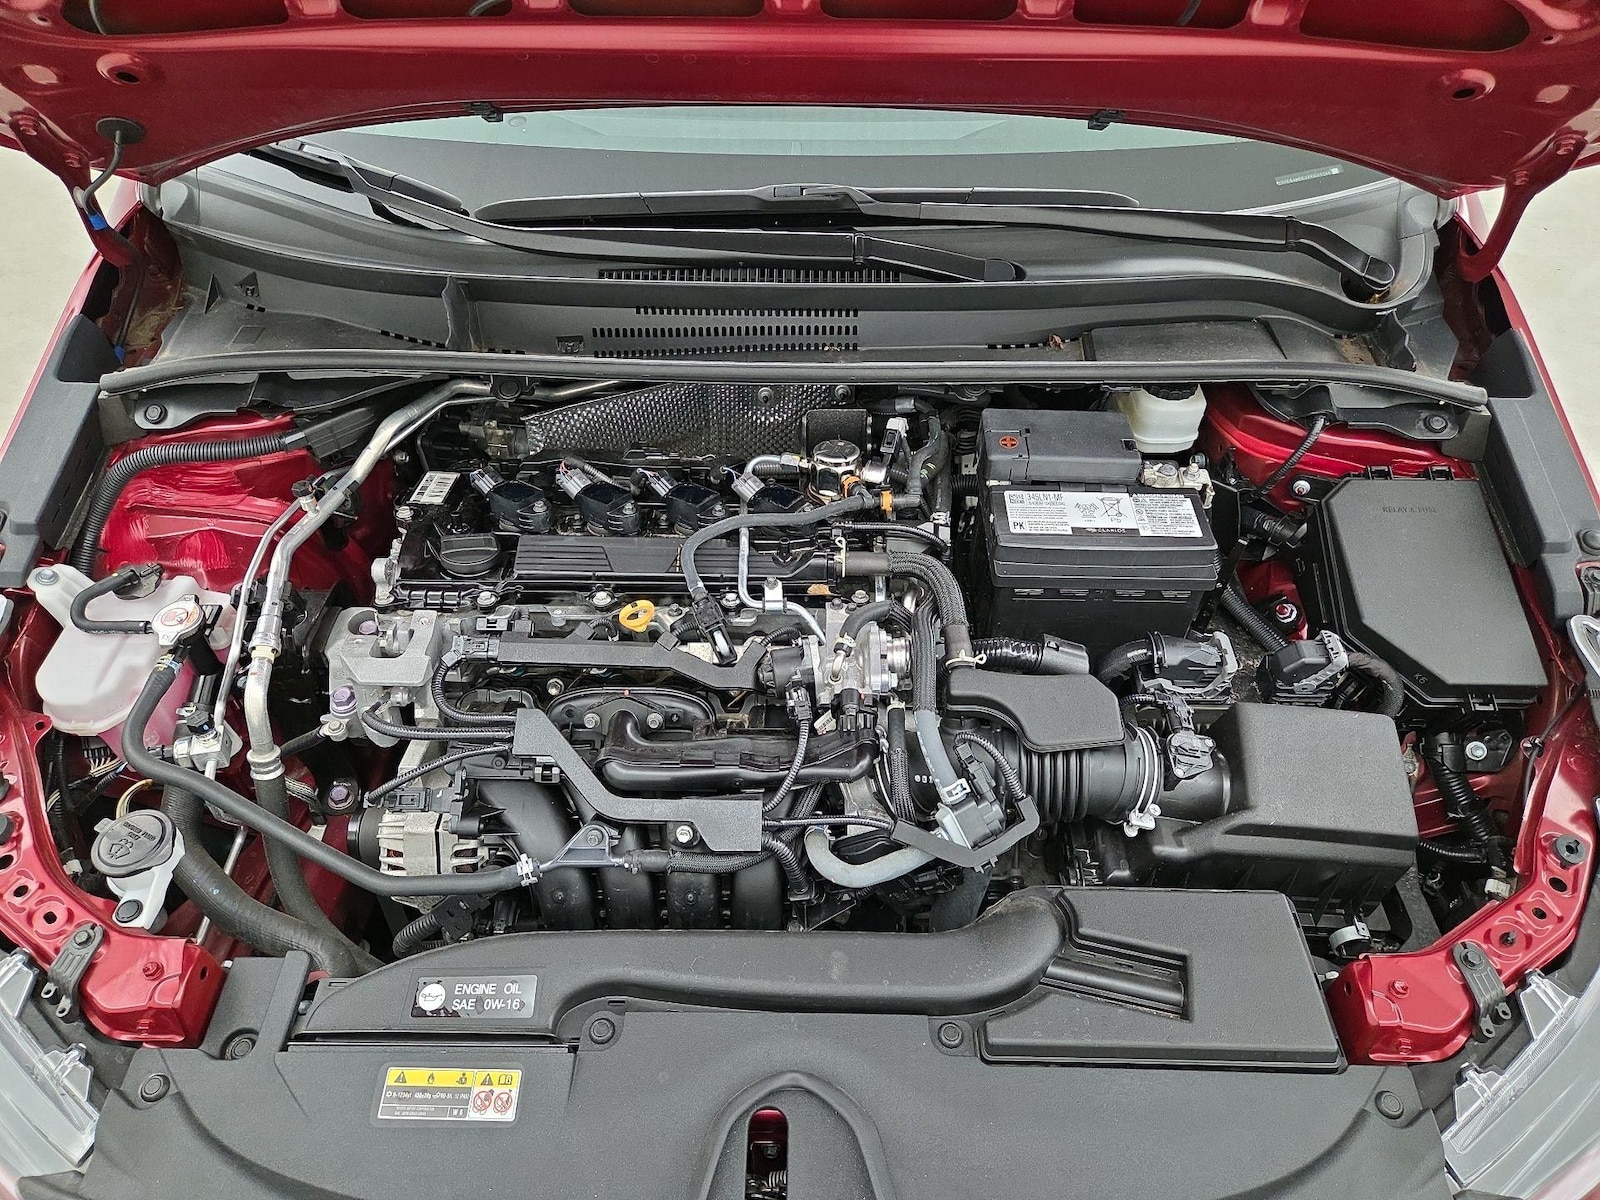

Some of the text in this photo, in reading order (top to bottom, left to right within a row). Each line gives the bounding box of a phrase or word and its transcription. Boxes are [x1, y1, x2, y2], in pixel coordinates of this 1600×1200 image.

[1013, 521, 1025, 530] PK
[454, 983, 523, 995] ENGINE OIL
[451, 998, 521, 1011] SAE 0W-16
